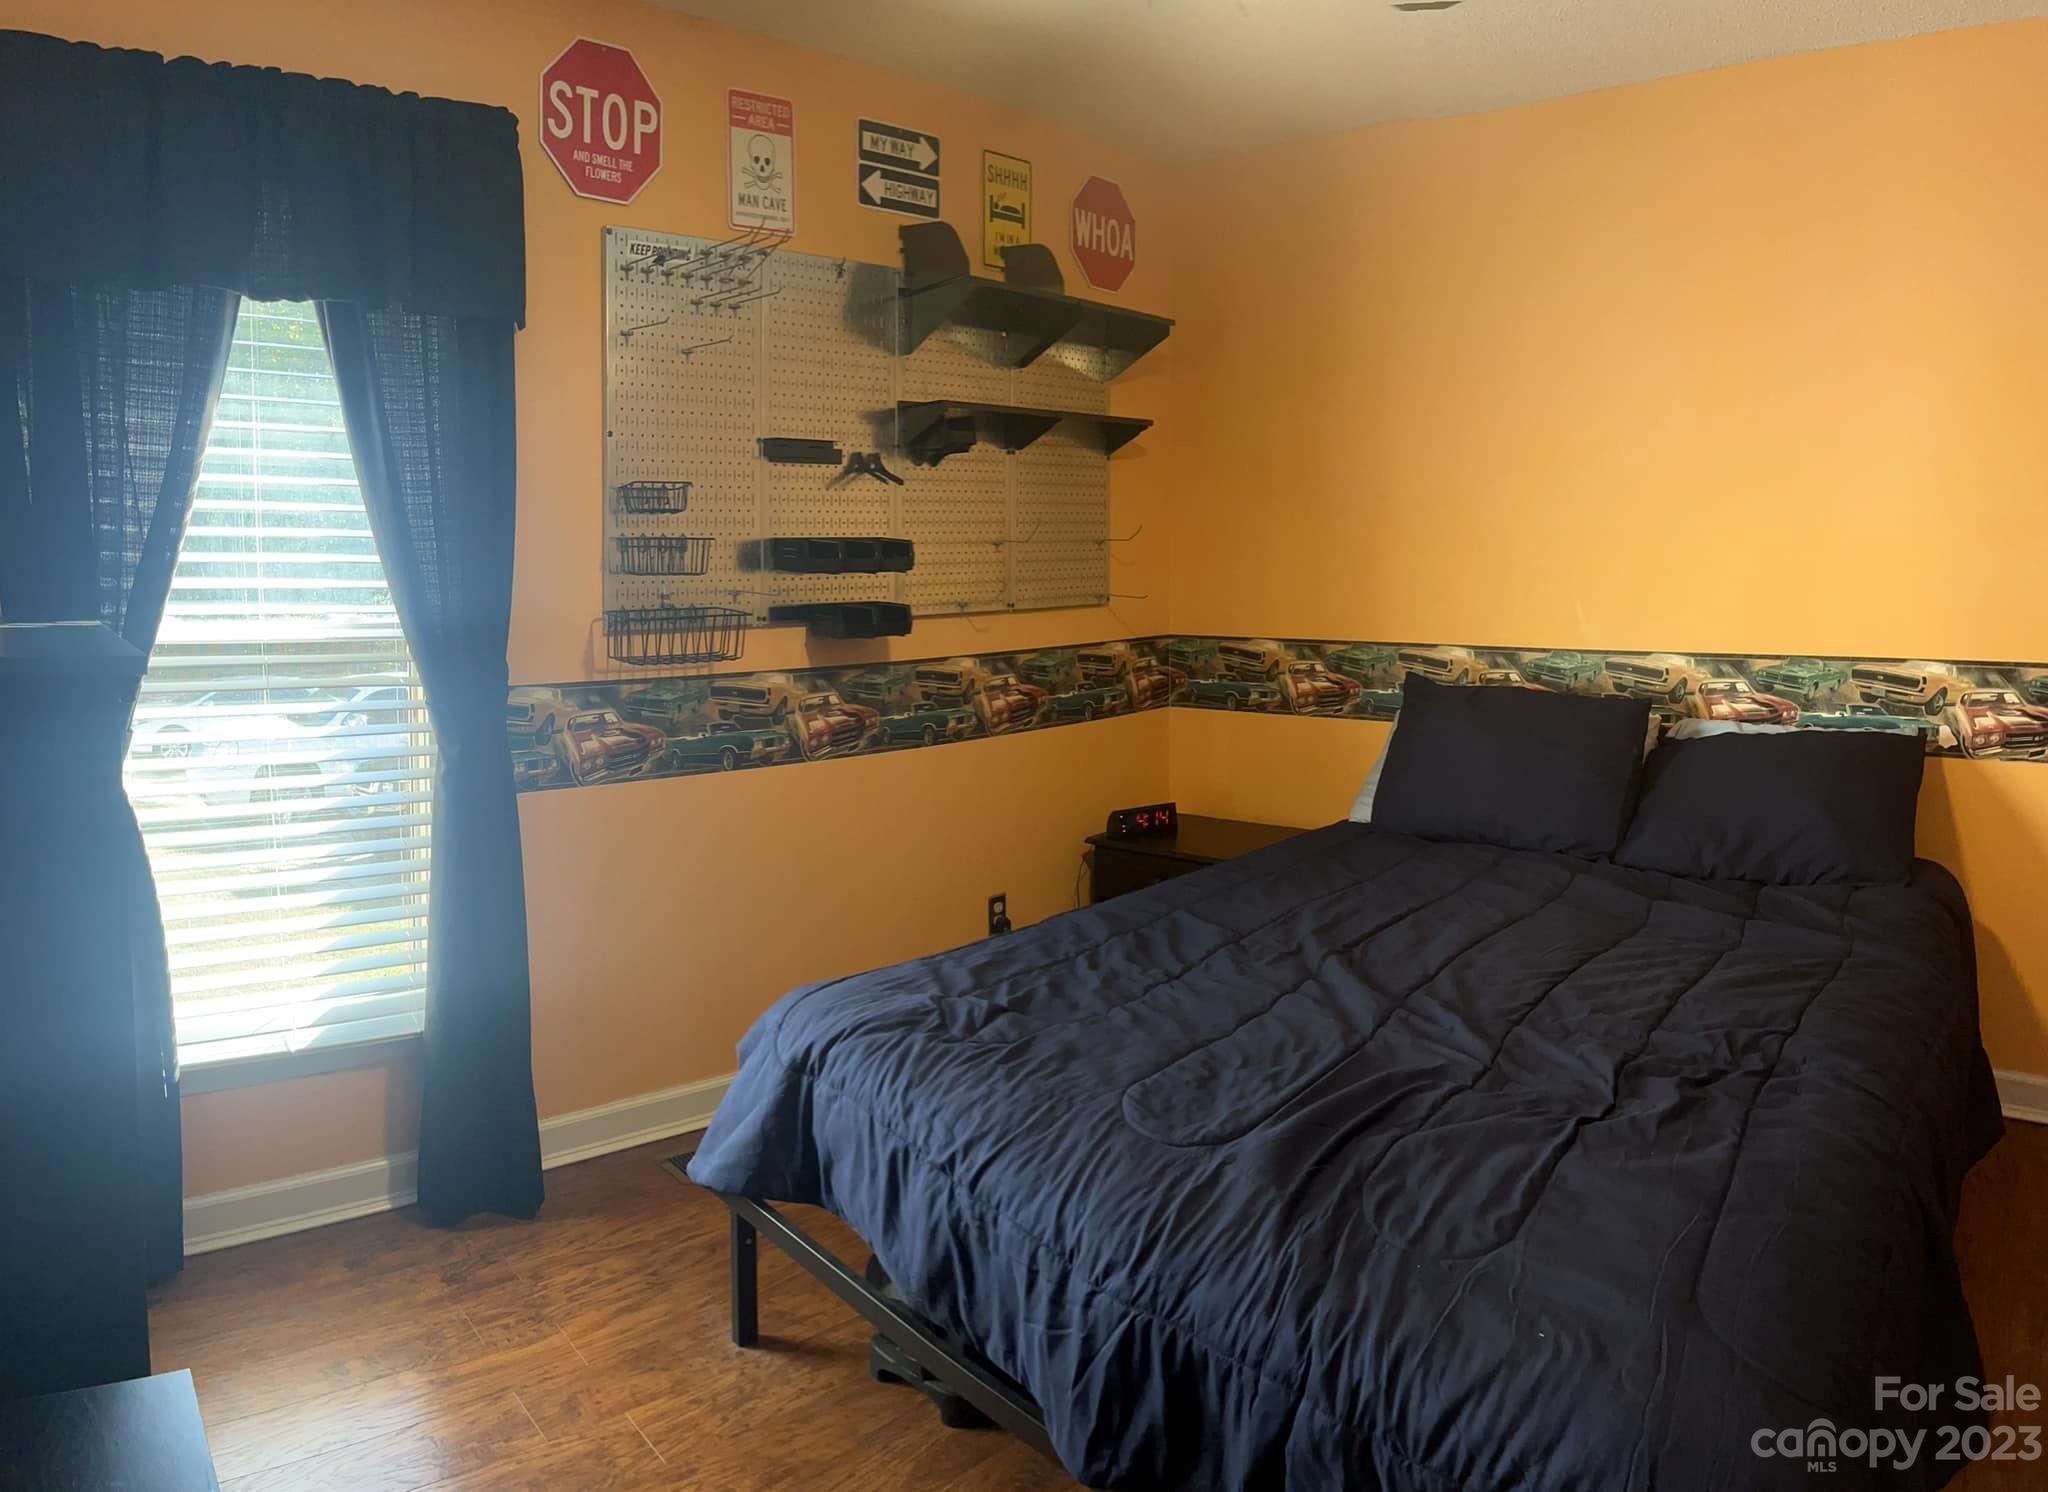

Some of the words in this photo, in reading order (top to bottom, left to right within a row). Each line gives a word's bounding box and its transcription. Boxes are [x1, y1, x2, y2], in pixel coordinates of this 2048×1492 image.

[547, 80, 658, 154] STOP
[731, 95, 790, 117] RESTRICTED
[747, 113, 775, 128] AREA
[870, 135, 886, 151] MY
[890, 141, 914, 159] WAY
[573, 149, 590, 163] AND
[592, 153, 617, 168] SMELL
[619, 159, 632, 172] THE
[585, 166, 622, 183] FLOWERS
[987, 164, 1027, 192] SHHHH
[738, 192, 759, 208] MAN
[762, 195, 787, 212] CAVE
[884, 181, 934, 204] HIGHWAY
[1074, 208, 1134, 261] WHOA
[630, 243, 651, 256] KEEP
